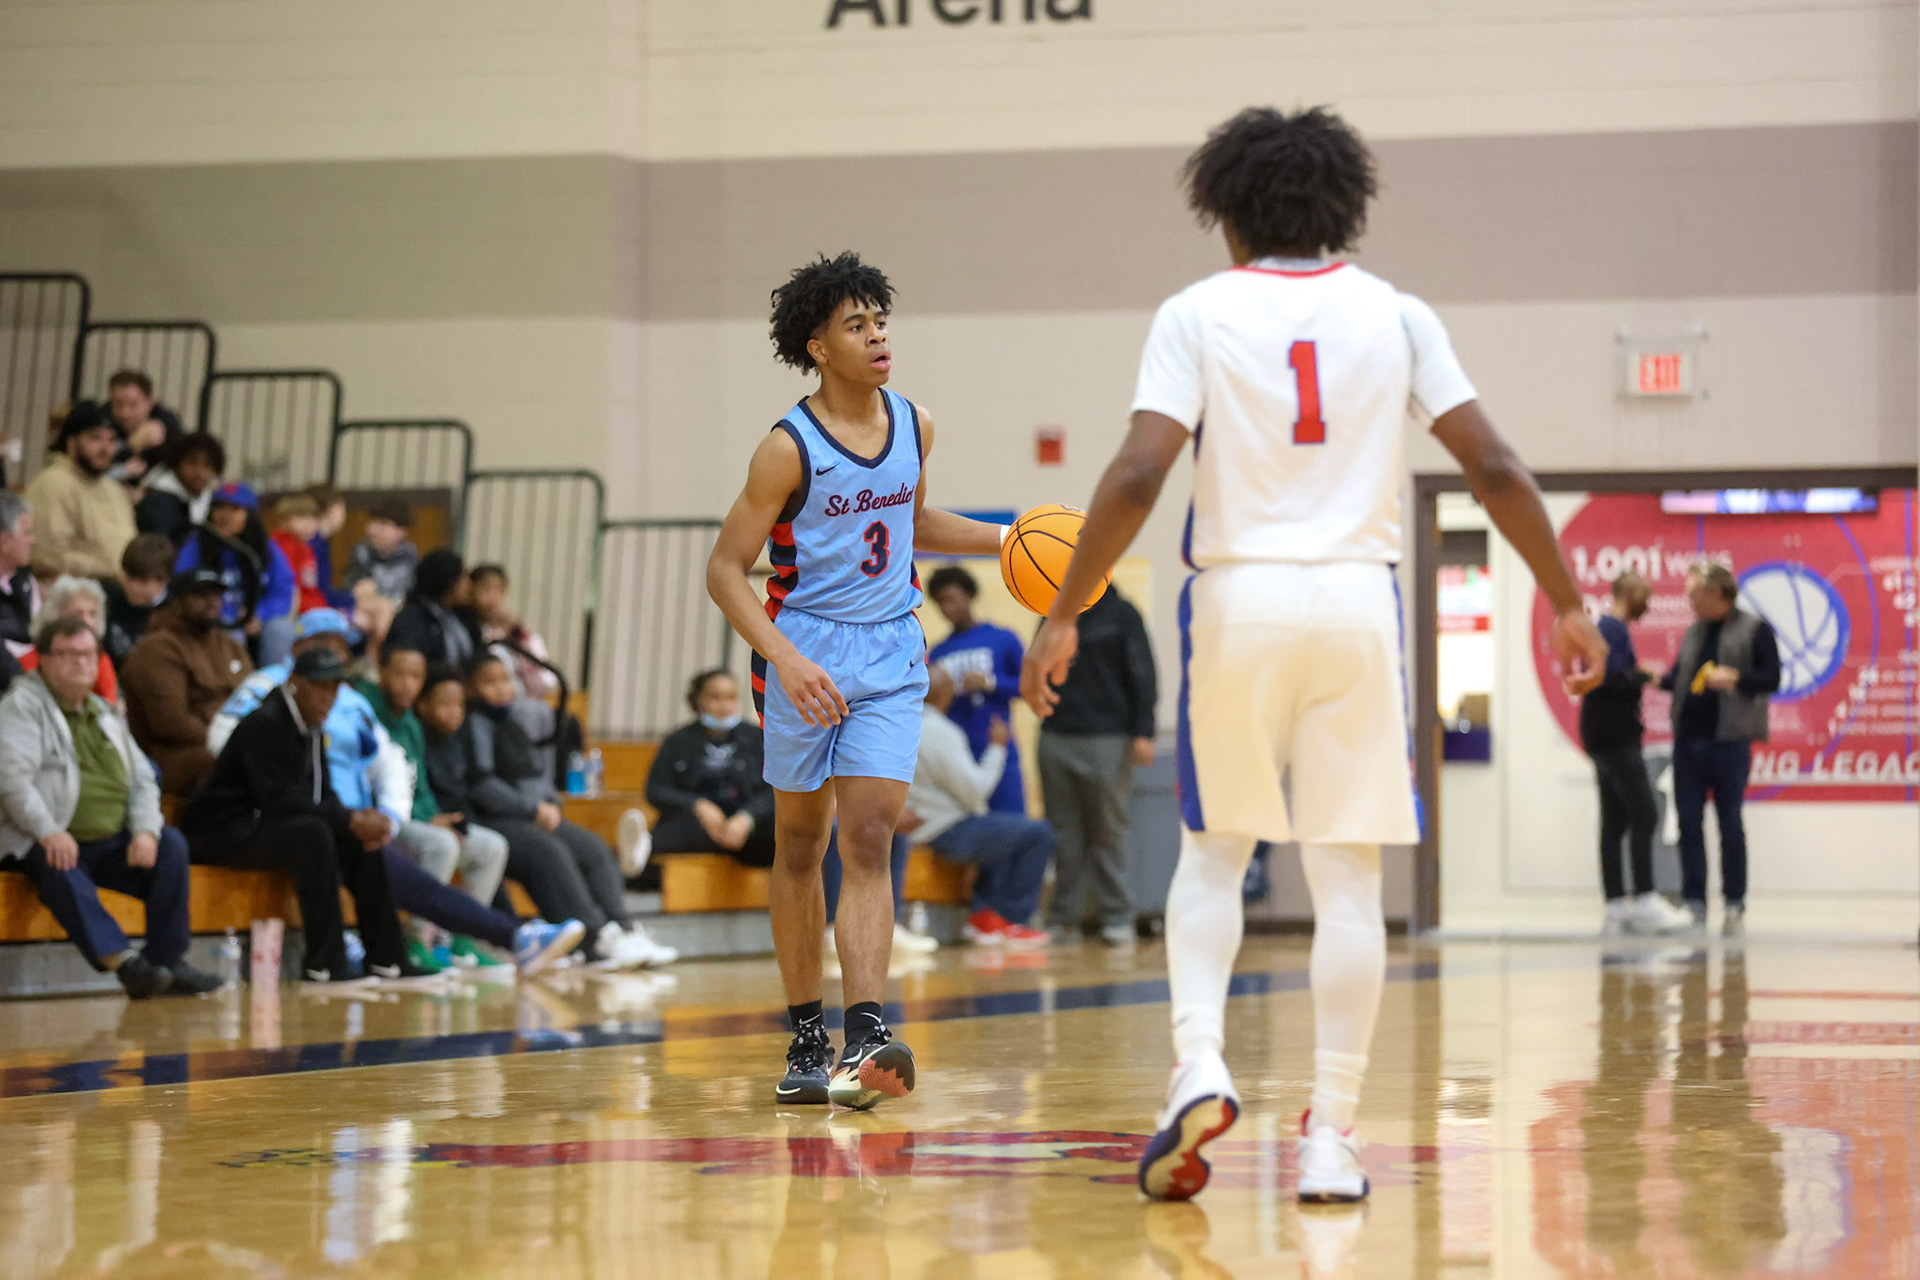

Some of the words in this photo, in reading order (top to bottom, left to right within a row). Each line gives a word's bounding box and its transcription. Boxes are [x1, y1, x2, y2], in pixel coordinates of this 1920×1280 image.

[1288, 340, 1326, 444] 1
[1639, 353, 1681, 393] EXIT
[824, 494, 850, 517] St
[860, 520, 890, 578] 3
[1571, 545, 1661, 586] 1,001
